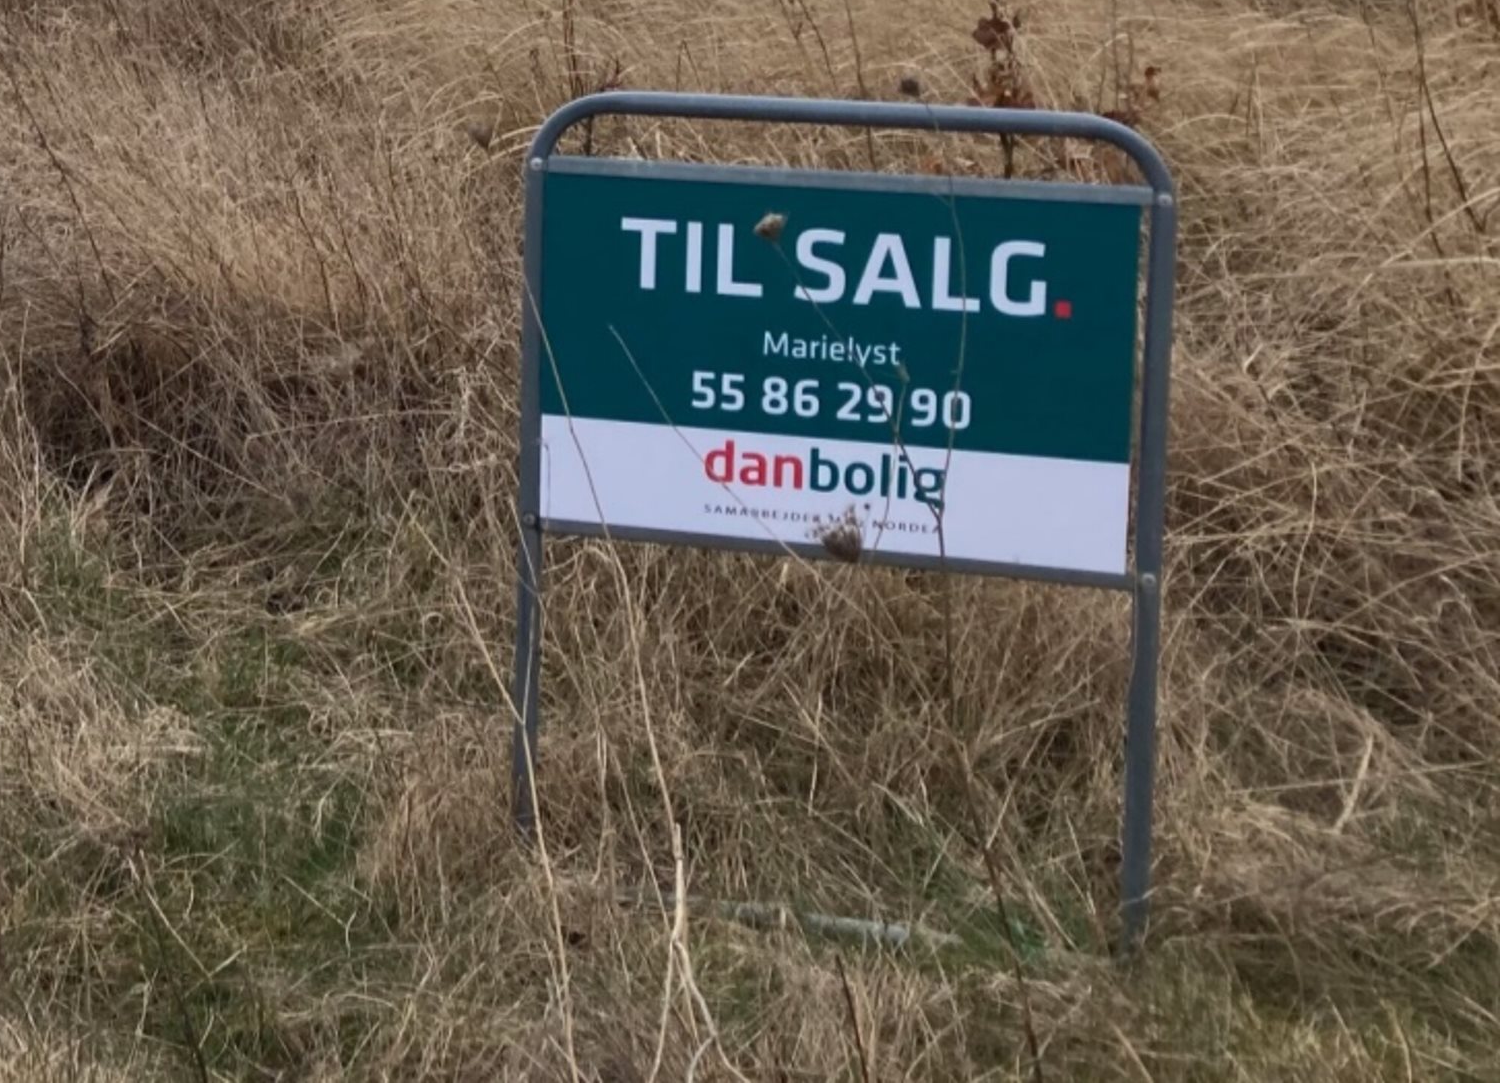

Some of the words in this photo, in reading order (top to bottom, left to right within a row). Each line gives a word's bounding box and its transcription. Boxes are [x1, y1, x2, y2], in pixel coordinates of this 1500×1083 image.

[621, 217, 763, 297] TIL
[794, 228, 1072, 317] SALG.
[763, 330, 901, 367] Marielyst
[691, 370, 745, 411] 55
[761, 376, 820, 417] 86
[836, 382, 894, 423] 29
[910, 388, 971, 429] 90
[704, 439, 945, 509] danbolig
